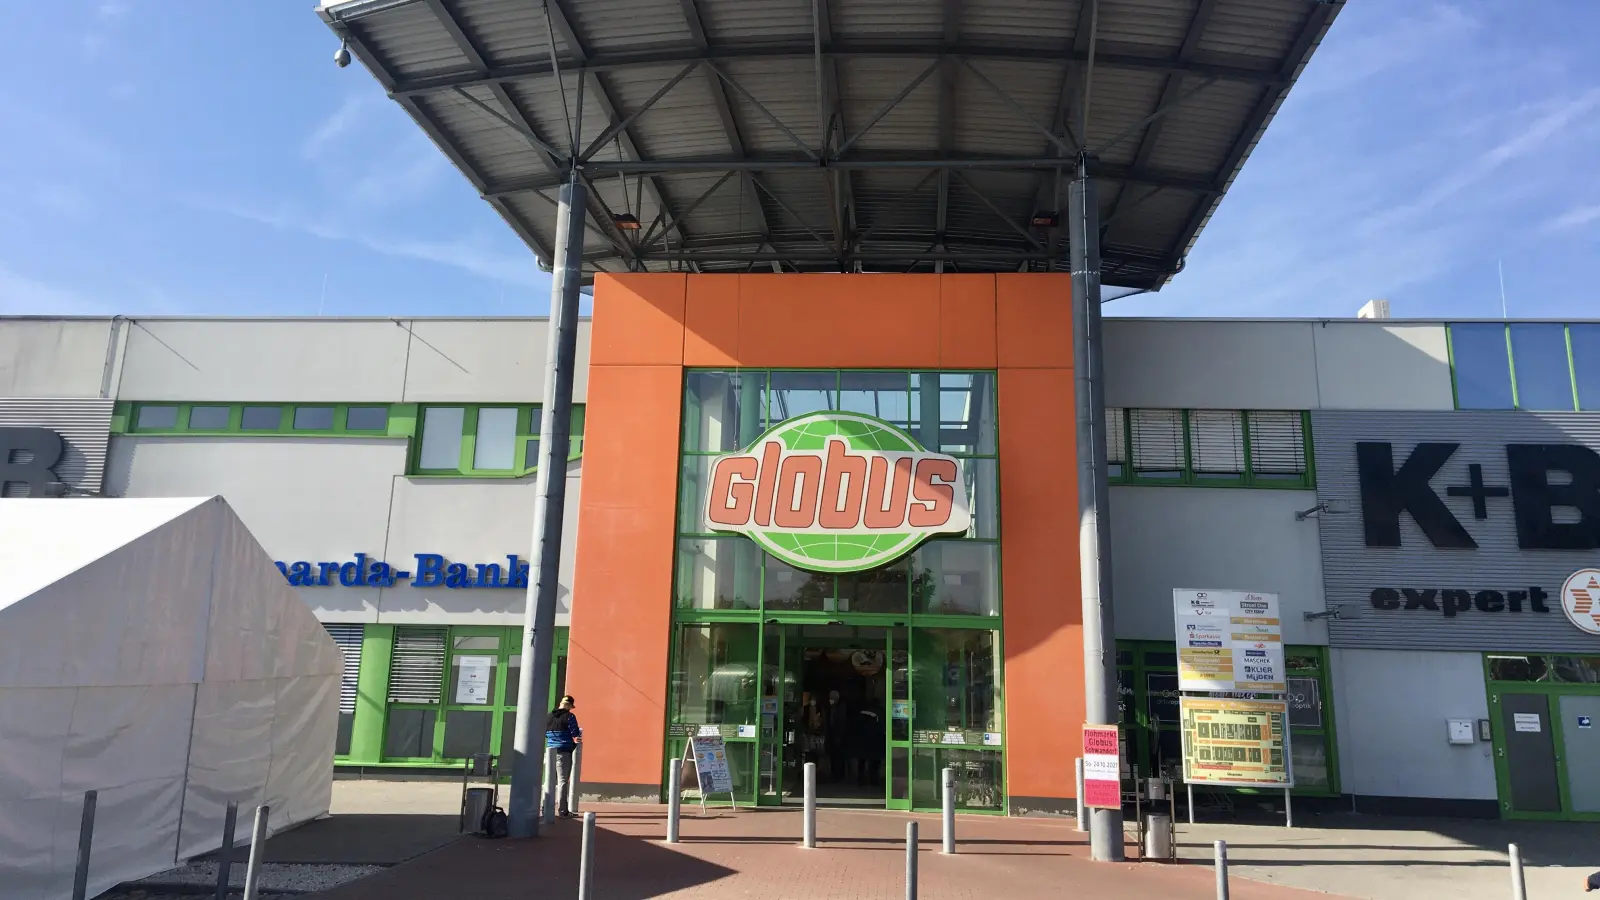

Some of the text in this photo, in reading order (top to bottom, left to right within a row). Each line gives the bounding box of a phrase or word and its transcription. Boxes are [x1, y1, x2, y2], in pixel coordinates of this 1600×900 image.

[708, 439, 958, 529] Globus
[1370, 586, 1550, 618] expert
[1084, 729, 1117, 738] Flohmarkt
[1088, 738, 1113, 747] Globus
[1084, 746, 1117, 755] Schwandorf
